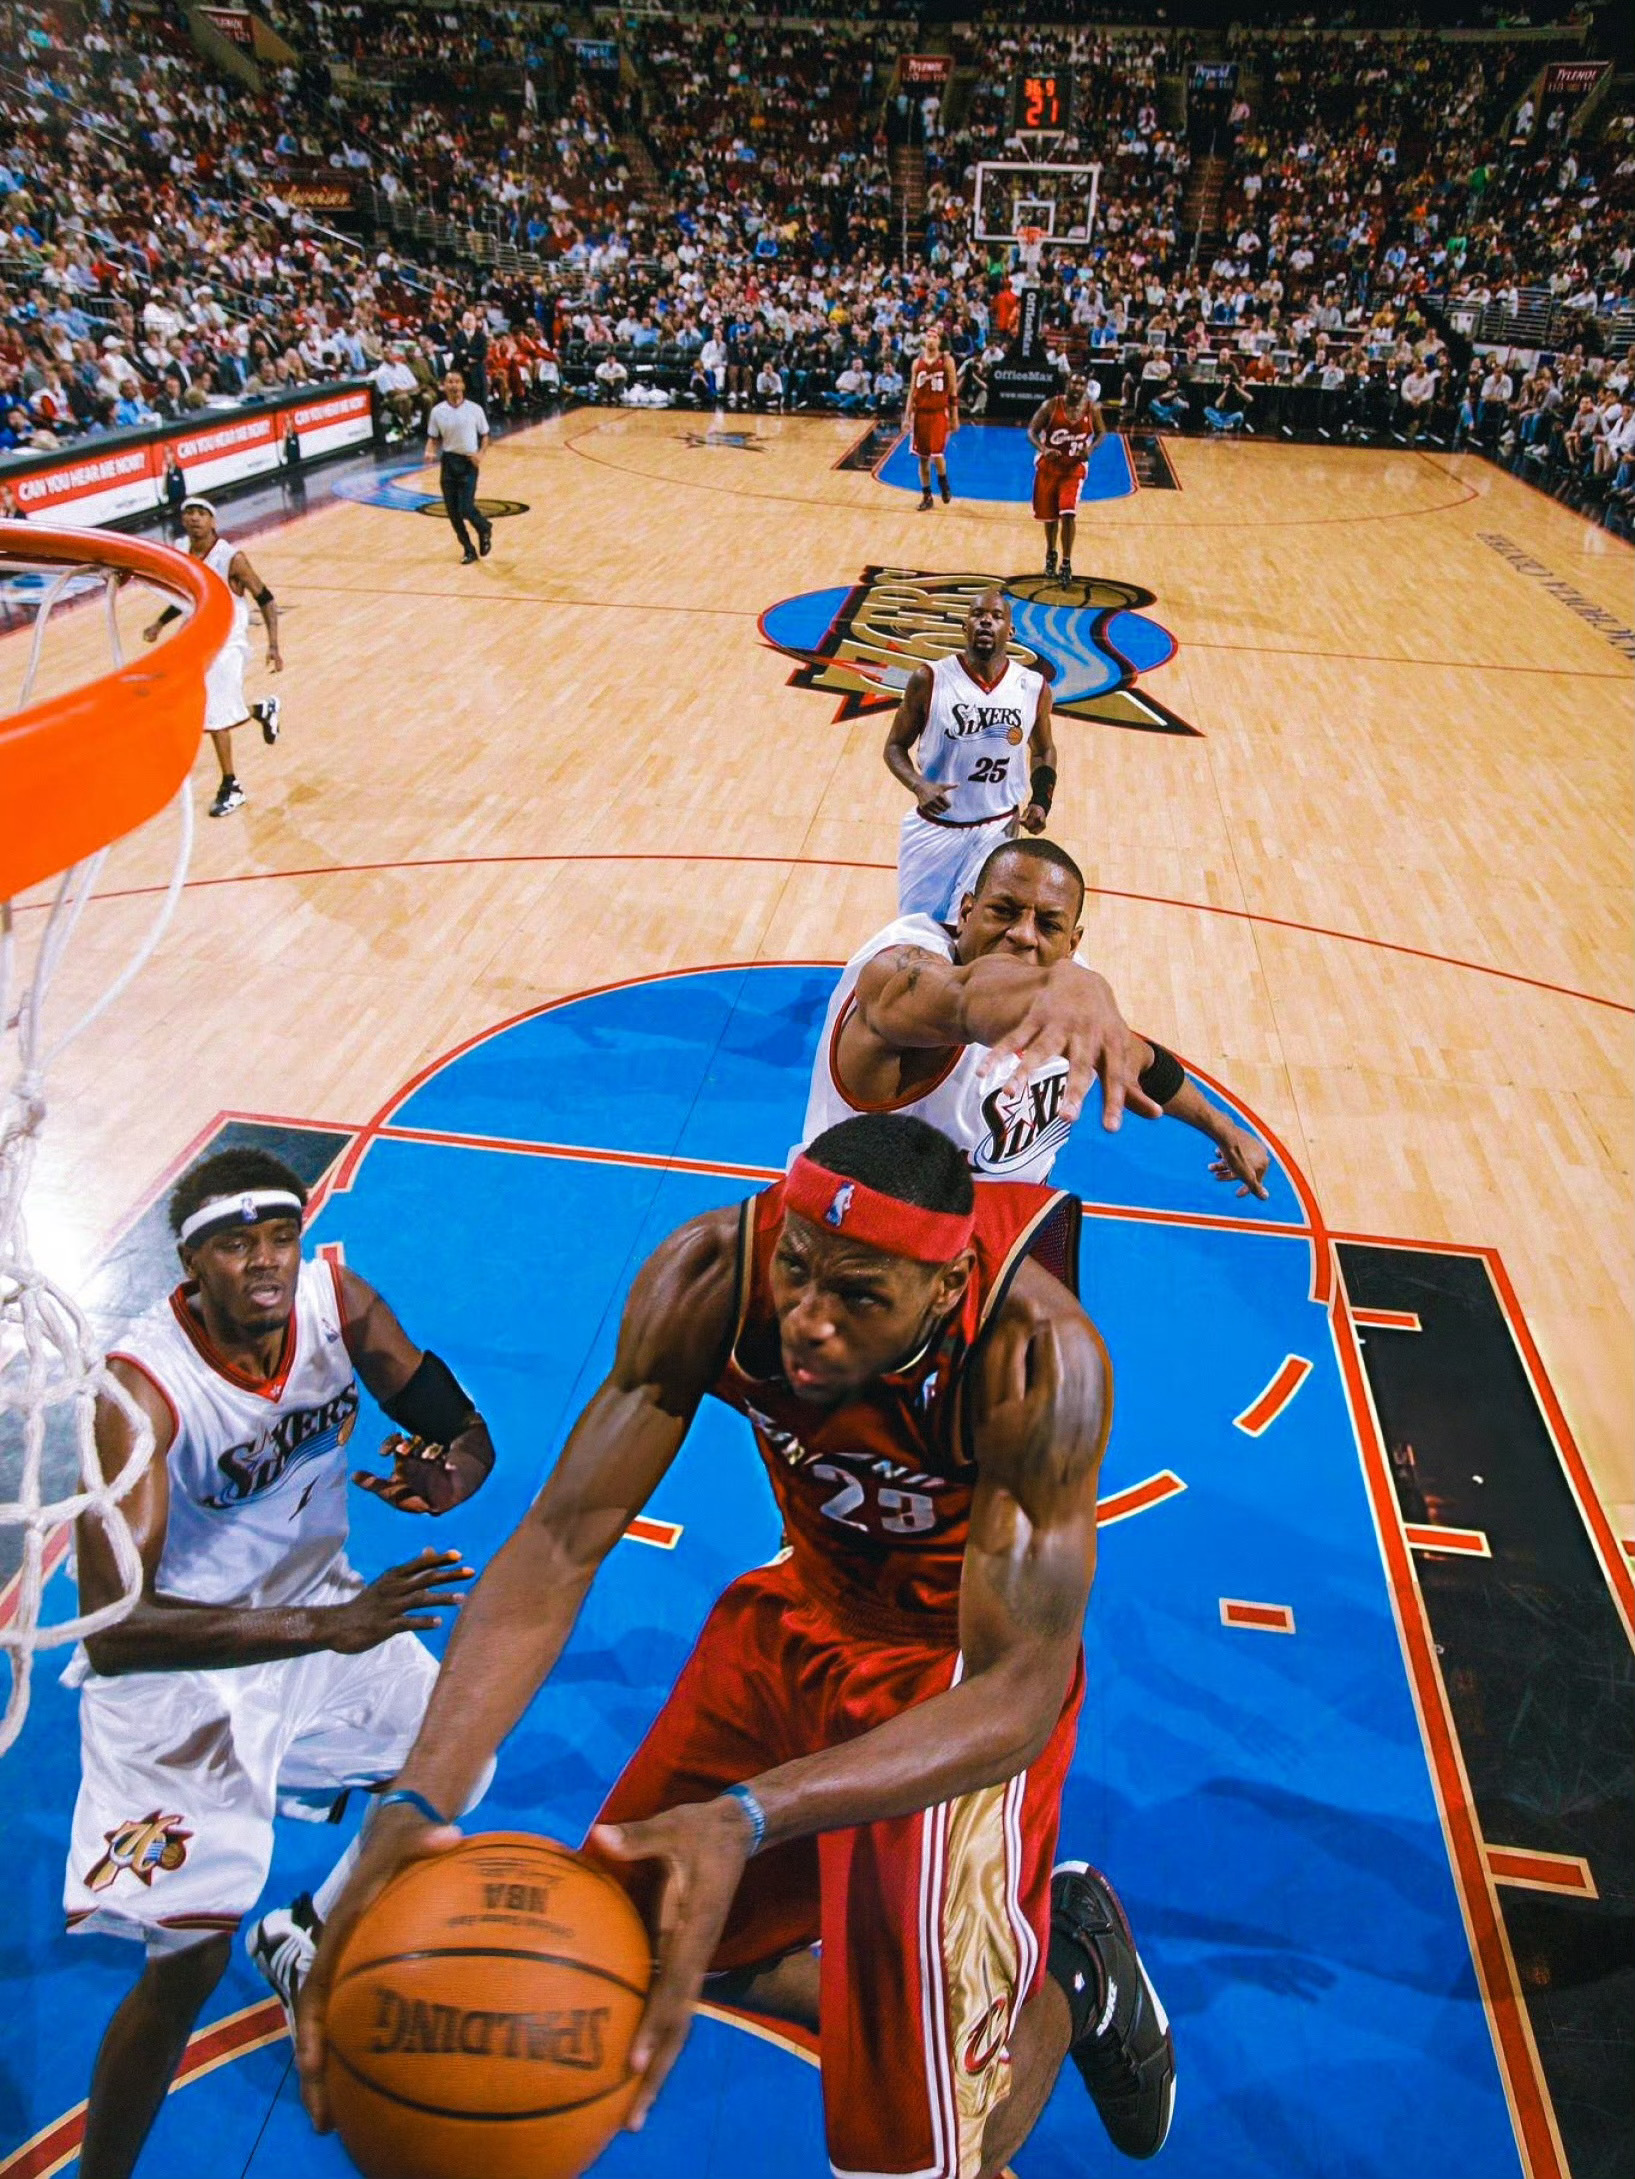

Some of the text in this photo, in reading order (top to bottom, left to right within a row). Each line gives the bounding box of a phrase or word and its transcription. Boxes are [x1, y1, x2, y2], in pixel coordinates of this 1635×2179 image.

[1027, 97, 1059, 127] 21
[994, 370, 1053, 382] OfficeMax
[18, 452, 145, 501] CAN YOU HEAR ME NOW?
[945, 703, 1032, 740] SIXERS
[968, 757, 1010, 783] 25
[972, 1071, 1069, 1172] SIXE
[288, 1474, 321, 1521] 1
[813, 1463, 936, 1533] 23
[371, 1985, 611, 2071] SPALDING
